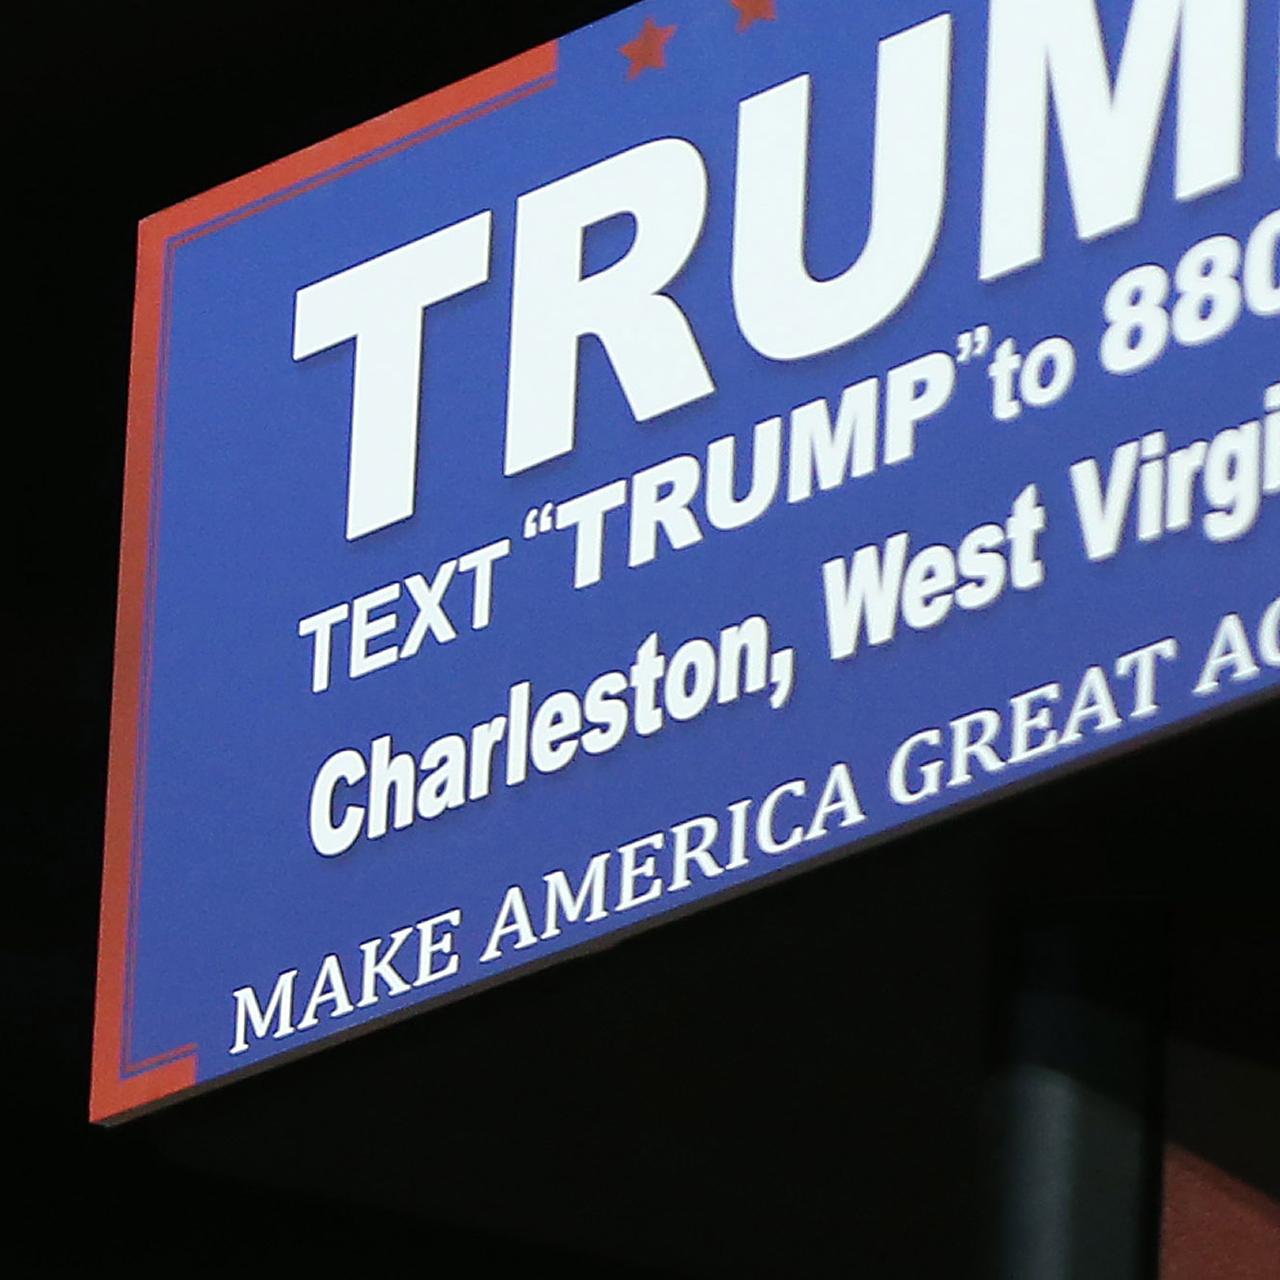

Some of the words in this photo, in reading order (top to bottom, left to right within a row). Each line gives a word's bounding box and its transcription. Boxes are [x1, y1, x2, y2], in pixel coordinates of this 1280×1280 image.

[298, 539, 510, 693] TEXT
[988, 337, 1075, 421] to
[310, 613, 793, 855] Charleston,
[822, 483, 1045, 660] West
[229, 909, 461, 1053] MAKE
[481, 763, 861, 958] AMERICA
[889, 638, 1177, 802] GREAT
